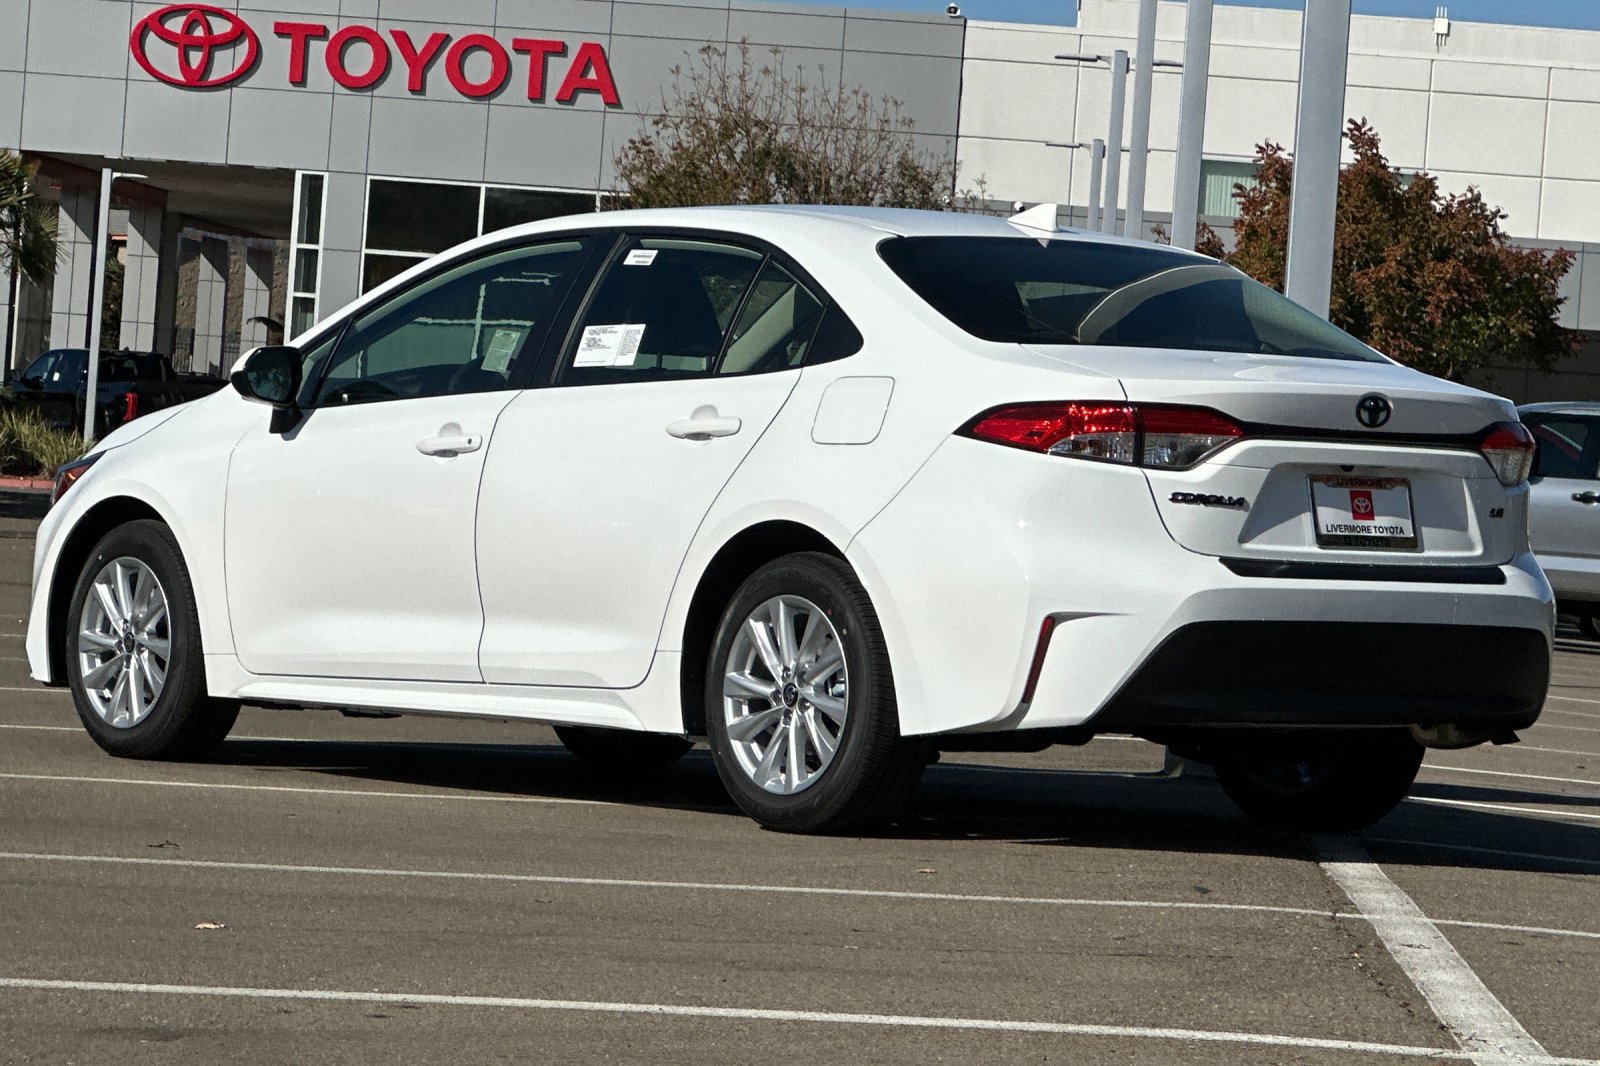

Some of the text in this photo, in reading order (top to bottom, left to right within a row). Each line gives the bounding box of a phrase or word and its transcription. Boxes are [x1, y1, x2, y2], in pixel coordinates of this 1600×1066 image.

[274, 21, 618, 106] TOYOTA
[1337, 477, 1383, 487] LIVERMORE
[1169, 492, 1245, 507] COROLLA
[1325, 524, 1405, 535] LIVERMORE TOYOTA
[1354, 536, 1391, 548] TOYOTA
